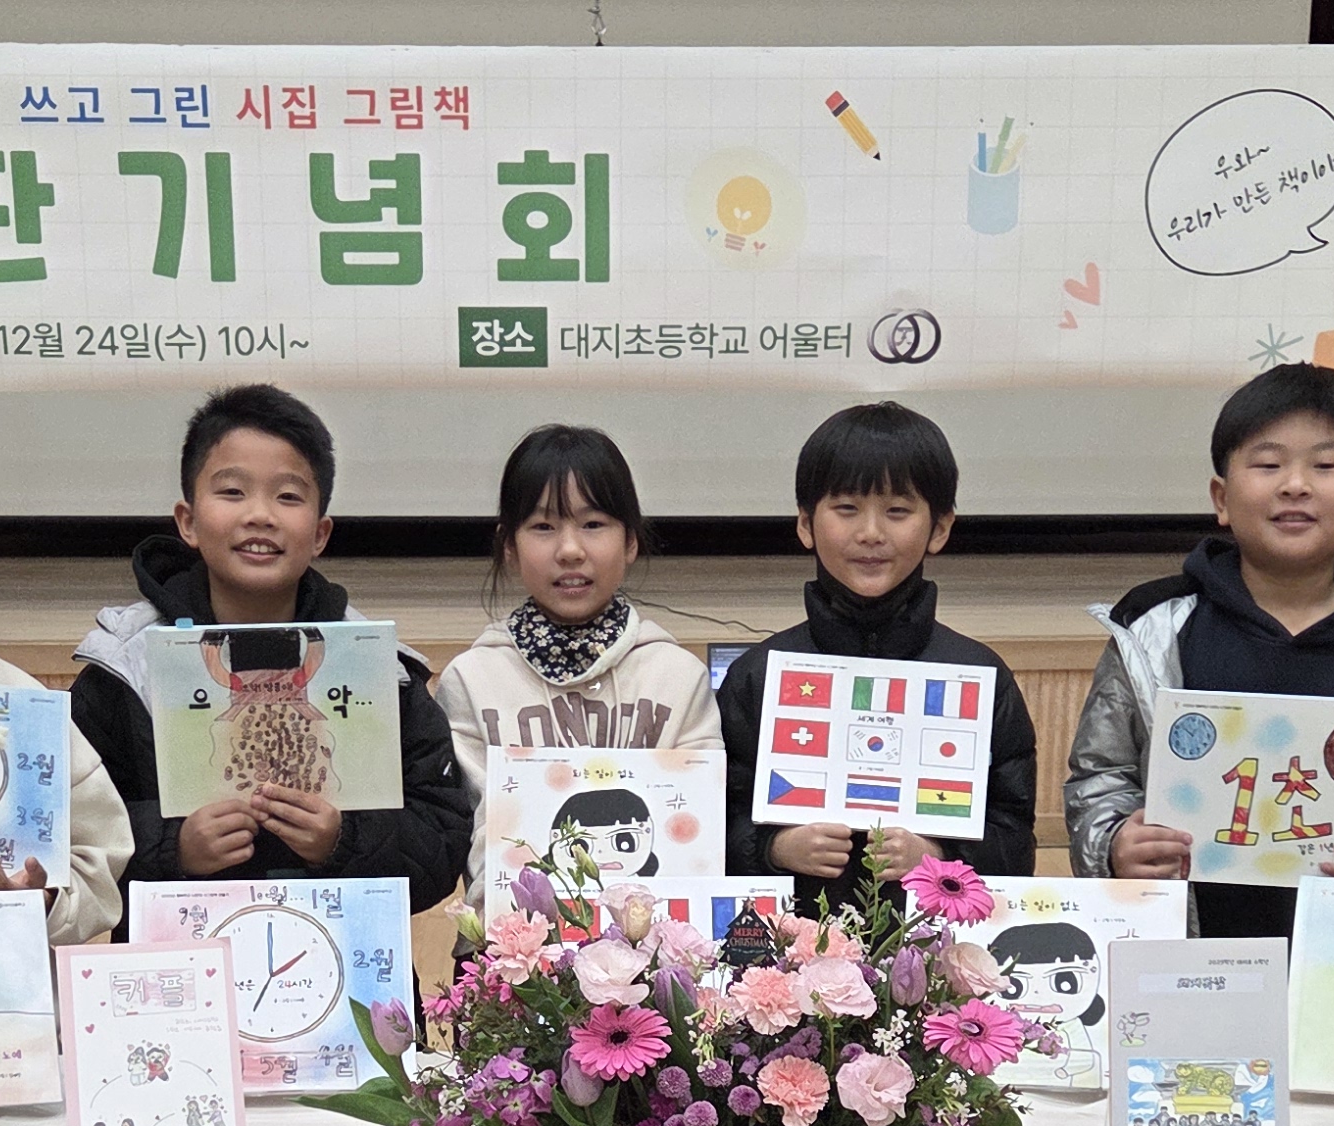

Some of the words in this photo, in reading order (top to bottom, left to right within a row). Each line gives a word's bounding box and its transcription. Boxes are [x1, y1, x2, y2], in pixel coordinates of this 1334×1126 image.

[20, 85, 105, 124] 쓰고
[129, 83, 211, 129] 그린
[236, 84, 318, 130] 시집
[343, 84, 469, 130] 그림책
[1213, 145, 1271, 180] 우와~
[1167, 203, 1227, 241] 우리가
[1233, 180, 1272, 217] 만든
[75, 322, 207, 361] 24일(수)
[217, 323, 311, 358] 10시~
[471, 319, 536, 357] 장소
[560, 322, 749, 360] 대지초등학교
[759, 322, 852, 359] 어울터
[17, 752, 55, 786] 2월
[729, 937, 768, 948] CHRISTMAS
[733, 927, 765, 937] MERRY
[353, 949, 394, 983] 2월
[113, 975, 184, 1008] 커플
[277, 978, 313, 989] 24시간
[260, 1056, 298, 1084] 5월
